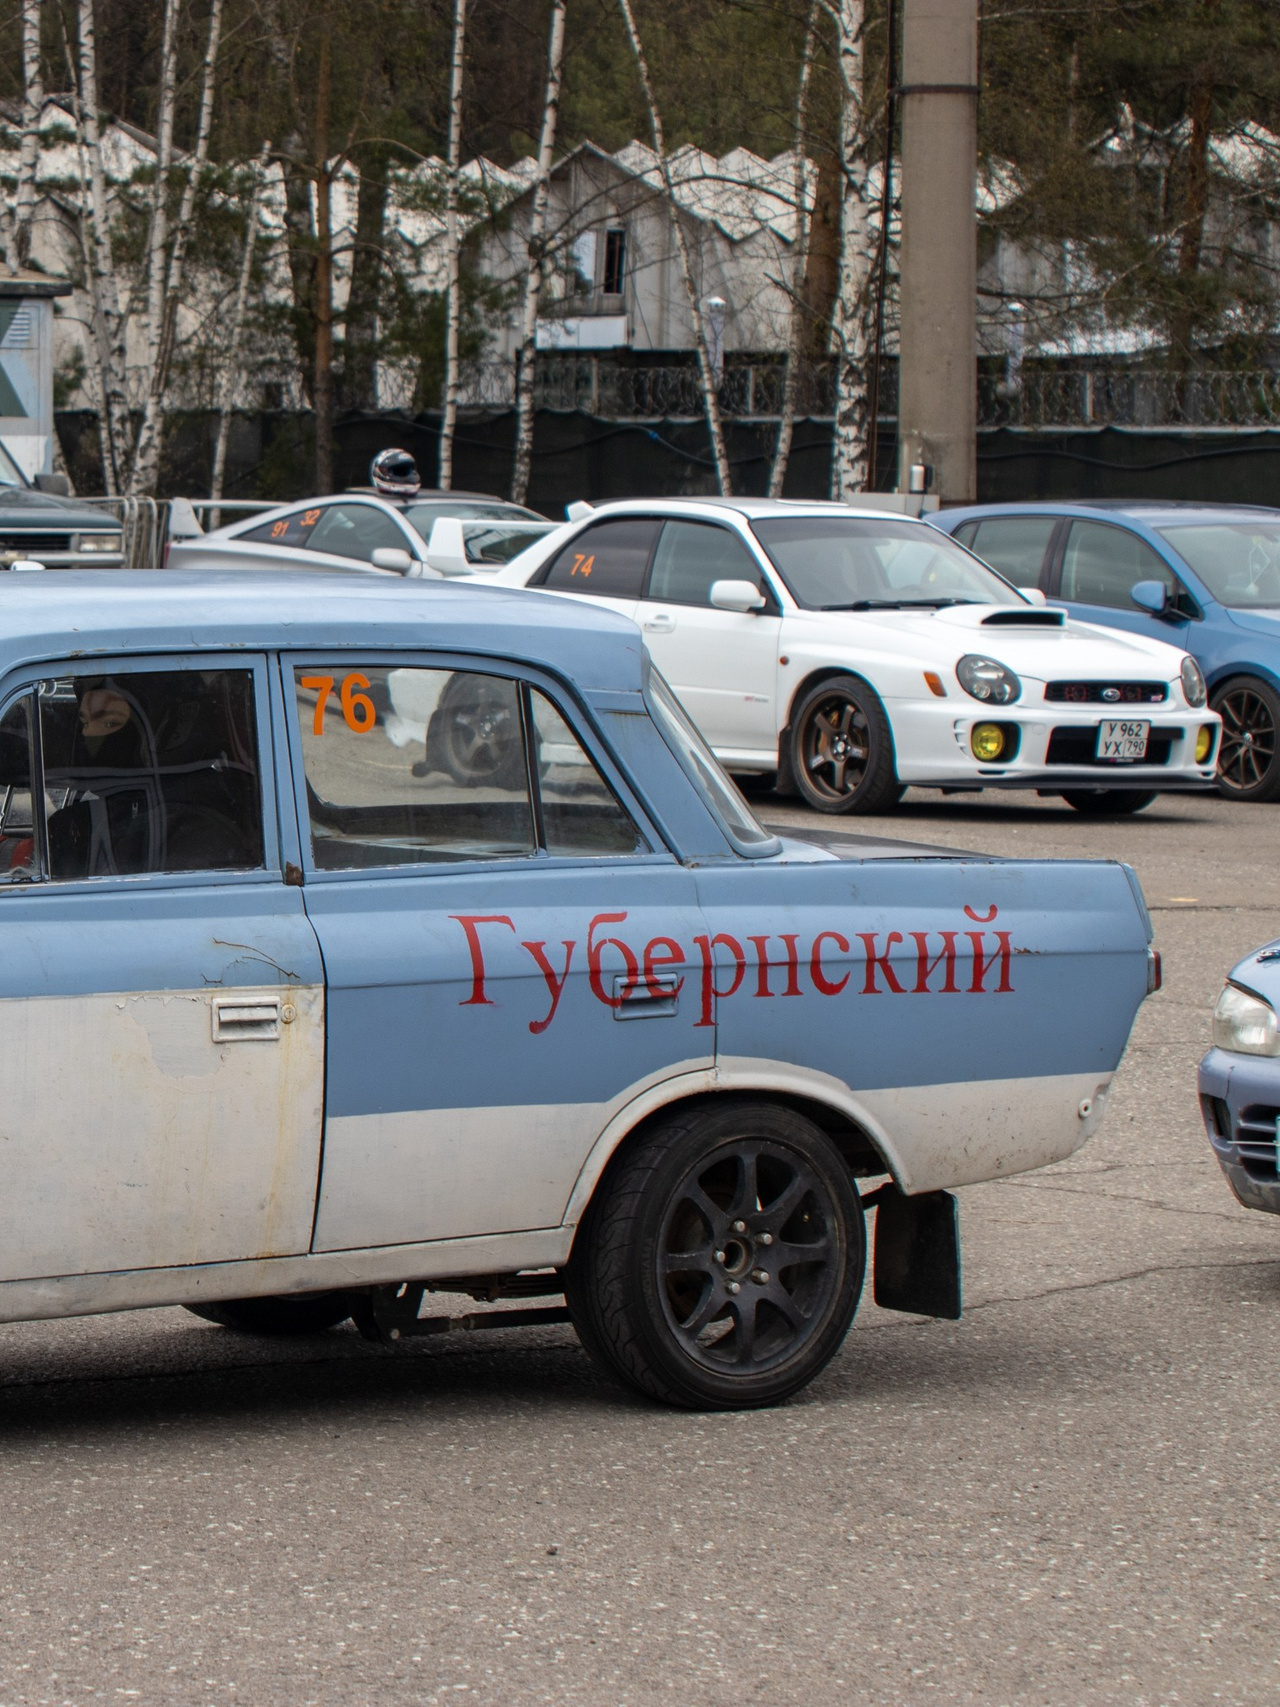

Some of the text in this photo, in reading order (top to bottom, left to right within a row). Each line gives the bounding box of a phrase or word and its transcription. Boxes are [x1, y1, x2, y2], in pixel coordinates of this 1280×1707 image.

[300, 509, 321, 526] 32
[271, 521, 289, 538] 91
[571, 553, 595, 577] 74
[301, 672, 376, 736] 76
[1120, 723, 1143, 737] 962
[1127, 740, 1145, 751] 790
[448, 904, 1016, 1034] Губернский
